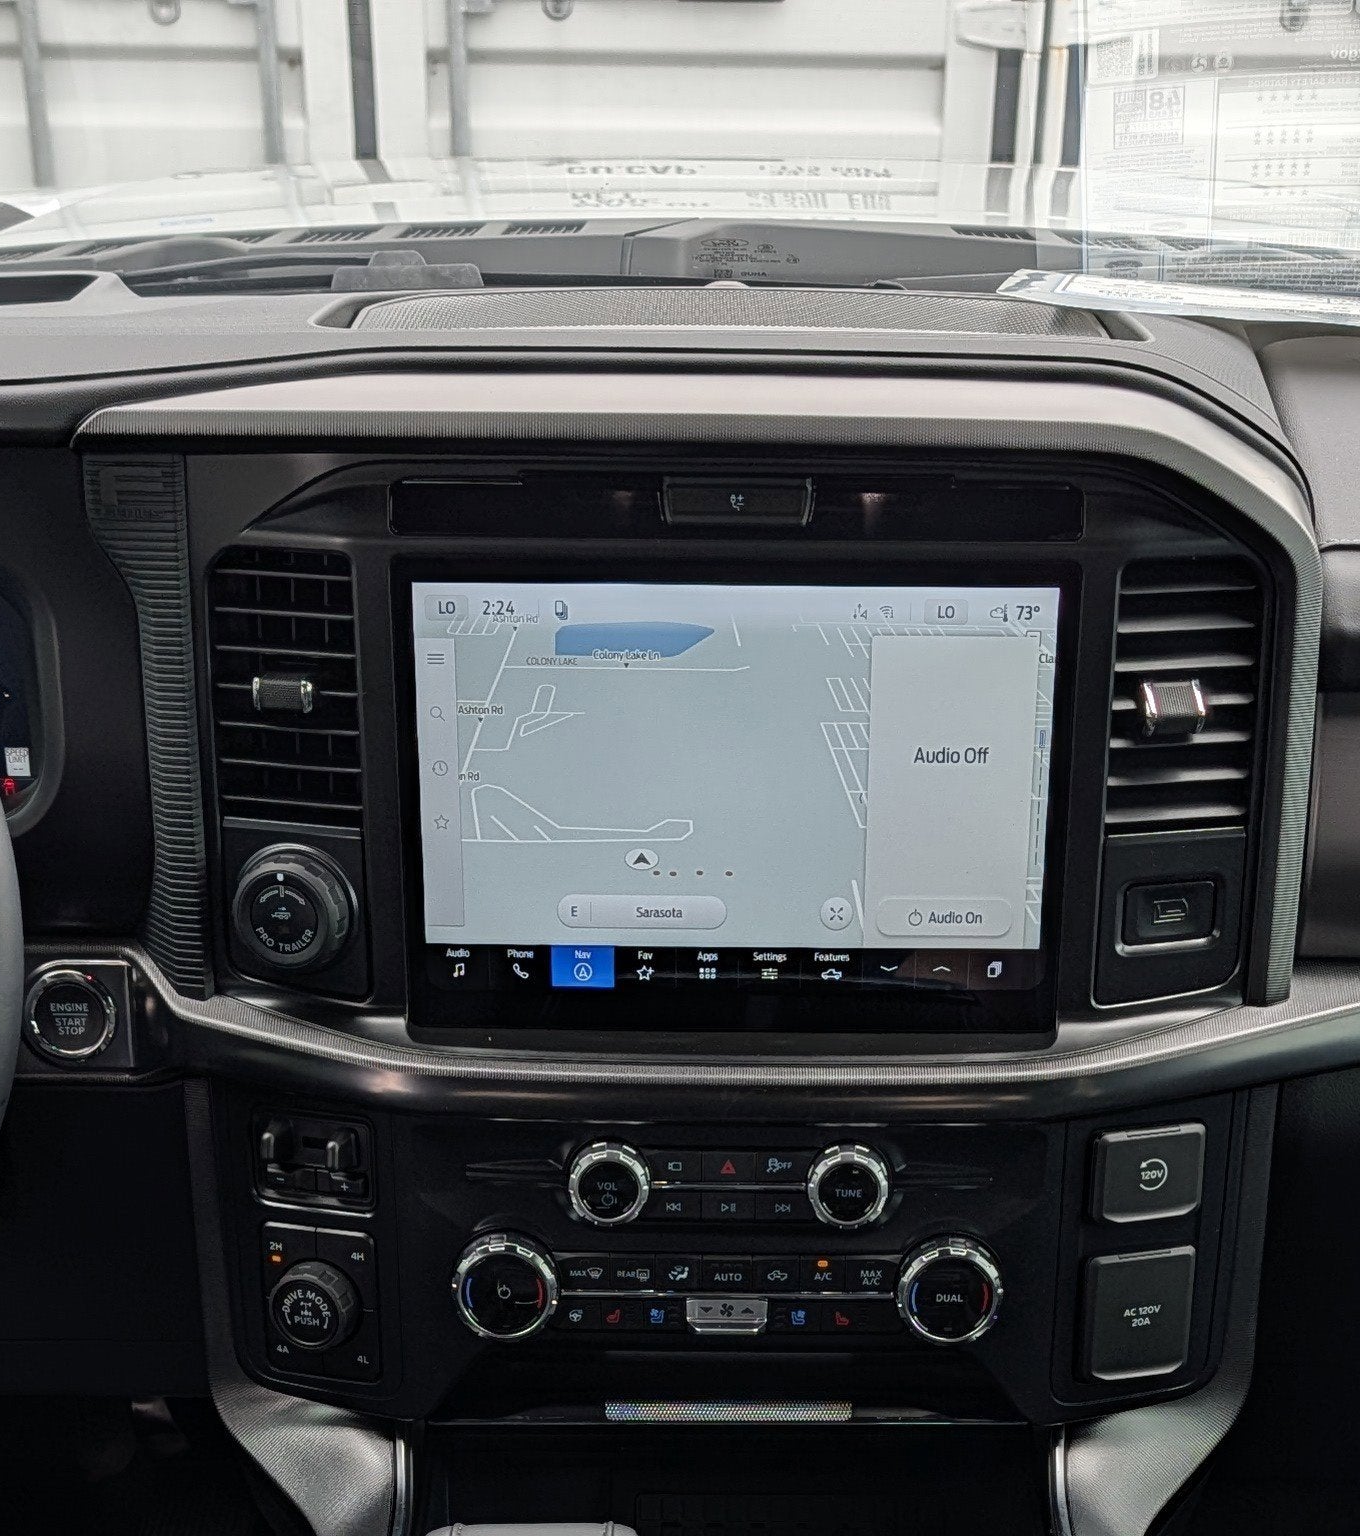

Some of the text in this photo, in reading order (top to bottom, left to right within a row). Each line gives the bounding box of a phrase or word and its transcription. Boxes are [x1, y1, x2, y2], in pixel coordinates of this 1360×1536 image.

[438, 601, 456, 615] LO
[482, 601, 515, 616] 2:24
[937, 605, 955, 619] LO
[1016, 605, 1040, 620] 73°
[593, 649, 624, 661] Colony
[626, 650, 647, 661] Lake
[526, 656, 578, 666] COLONY LAKE
[458, 705, 503, 715] Ashton Rd
[913, 746, 989, 764] Audio Off
[467, 771, 480, 780] Rd
[570, 906, 578, 917] E
[635, 906, 683, 918] Sarasota
[927, 911, 982, 924] Audio On
[255, 926, 315, 953] PRO TRAILER
[446, 948, 470, 958] Audio
[507, 948, 534, 959] Phone
[574, 949, 591, 959] Nav
[638, 951, 653, 960] Fav
[697, 951, 718, 962] Apps
[752, 951, 787, 963] Settings
[814, 951, 850, 962] Features
[49, 1002, 89, 1013] ENGINE
[55, 1017, 86, 1027] START
[58, 1025, 86, 1036] STOP
[1141, 1168, 1163, 1181] 120V
[597, 1181, 618, 1191] VOL
[835, 1188, 863, 1199] TUNE
[269, 1241, 283, 1251] 2H
[351, 1252, 365, 1261] 4H
[569, 1269, 587, 1278] MAX
[616, 1270, 637, 1279] REAR
[714, 1272, 742, 1282] AUTO
[814, 1271, 833, 1282] A/C
[860, 1269, 883, 1278] MAX
[862, 1277, 881, 1287] A/C
[281, 1289, 331, 1317] DRIVE MODE
[935, 1293, 963, 1303] DUAL
[1123, 1304, 1161, 1317] AC 120V
[294, 1315, 320, 1326] PUSH
[1131, 1317, 1151, 1328] 20A
[276, 1344, 290, 1354] 4A
[357, 1355, 370, 1365] 4L
